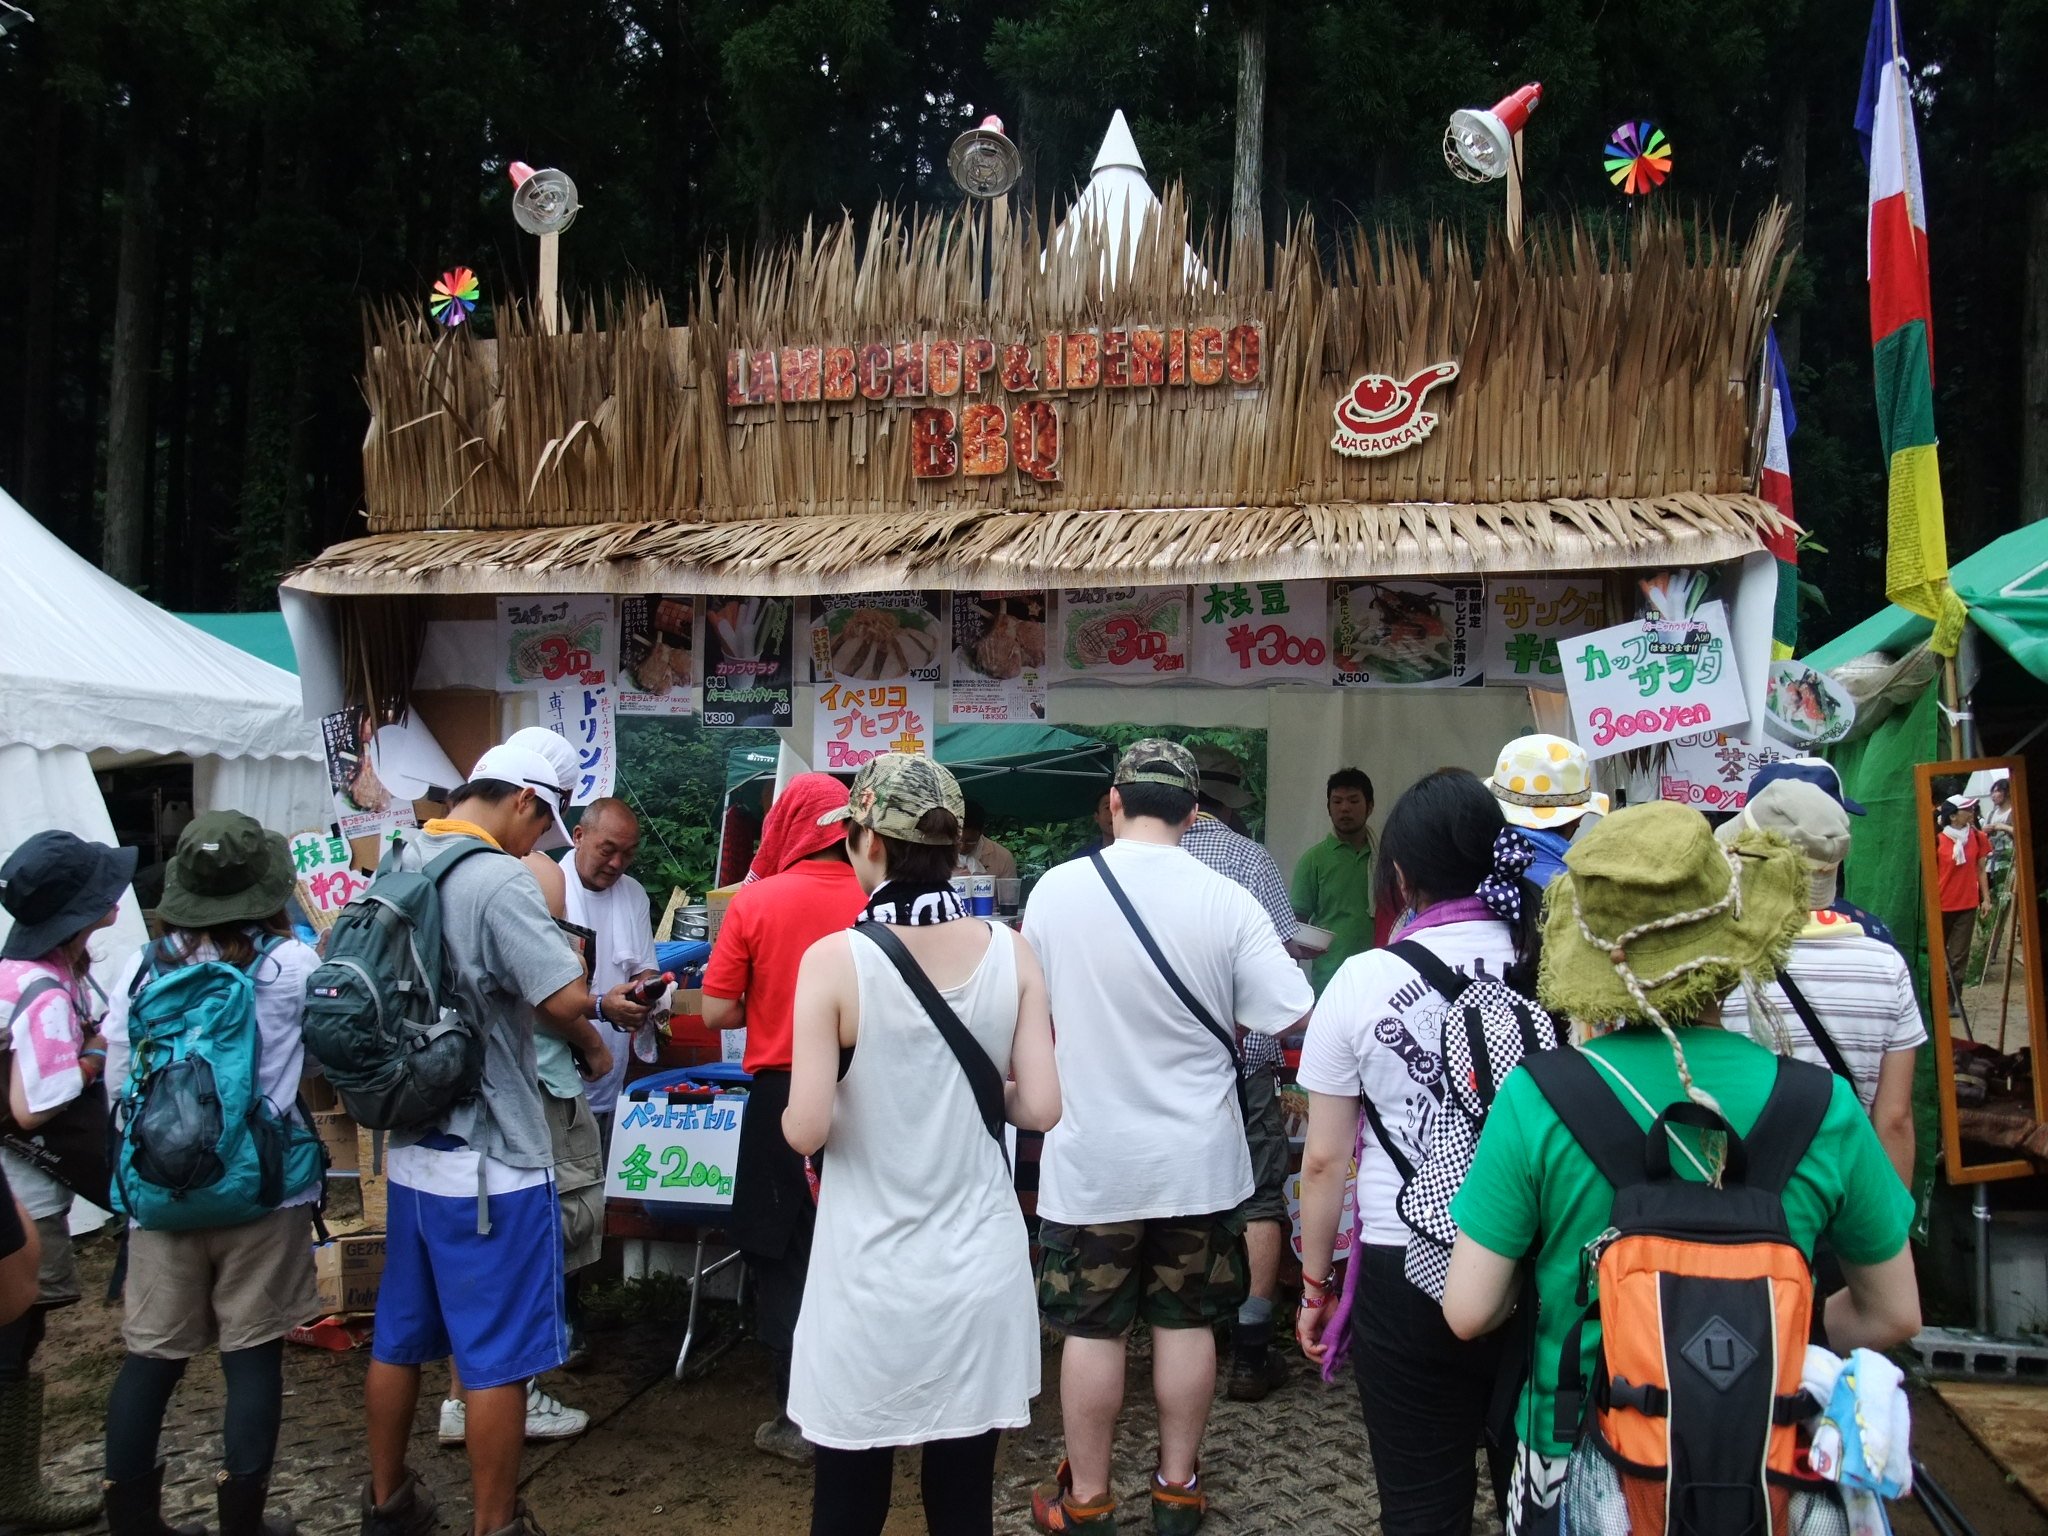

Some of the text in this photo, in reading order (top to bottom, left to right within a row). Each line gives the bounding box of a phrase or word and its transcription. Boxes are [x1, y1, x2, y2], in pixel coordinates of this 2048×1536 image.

[1046, 325, 1265, 390] IBERICO
[912, 401, 1062, 481] BBQ
[1335, 415, 1434, 452] NAGAOKAYA
[1201, 583, 1290, 624] 枝豆
[1468, 587, 1482, 629] 朝限定
[1226, 623, 1326, 669] ¥300
[1453, 588, 1468, 677] 蒸しどり茶漬け
[910, 669, 938, 678] ¥700
[1338, 672, 1369, 683] ¥500
[1577, 632, 1659, 682] カップ
[1629, 638, 1722, 697] サラダ
[706, 676, 726, 688] 特製
[819, 684, 907, 711] イベリコ
[704, 712, 735, 724] ¥300
[833, 707, 925, 740] ブヒブヒ
[577, 687, 605, 799] ドリンク
[293, 837, 348, 873] 枝豆
[622, 1102, 737, 1131] ペットボトル
[618, 1144, 733, 1196] 各200円
